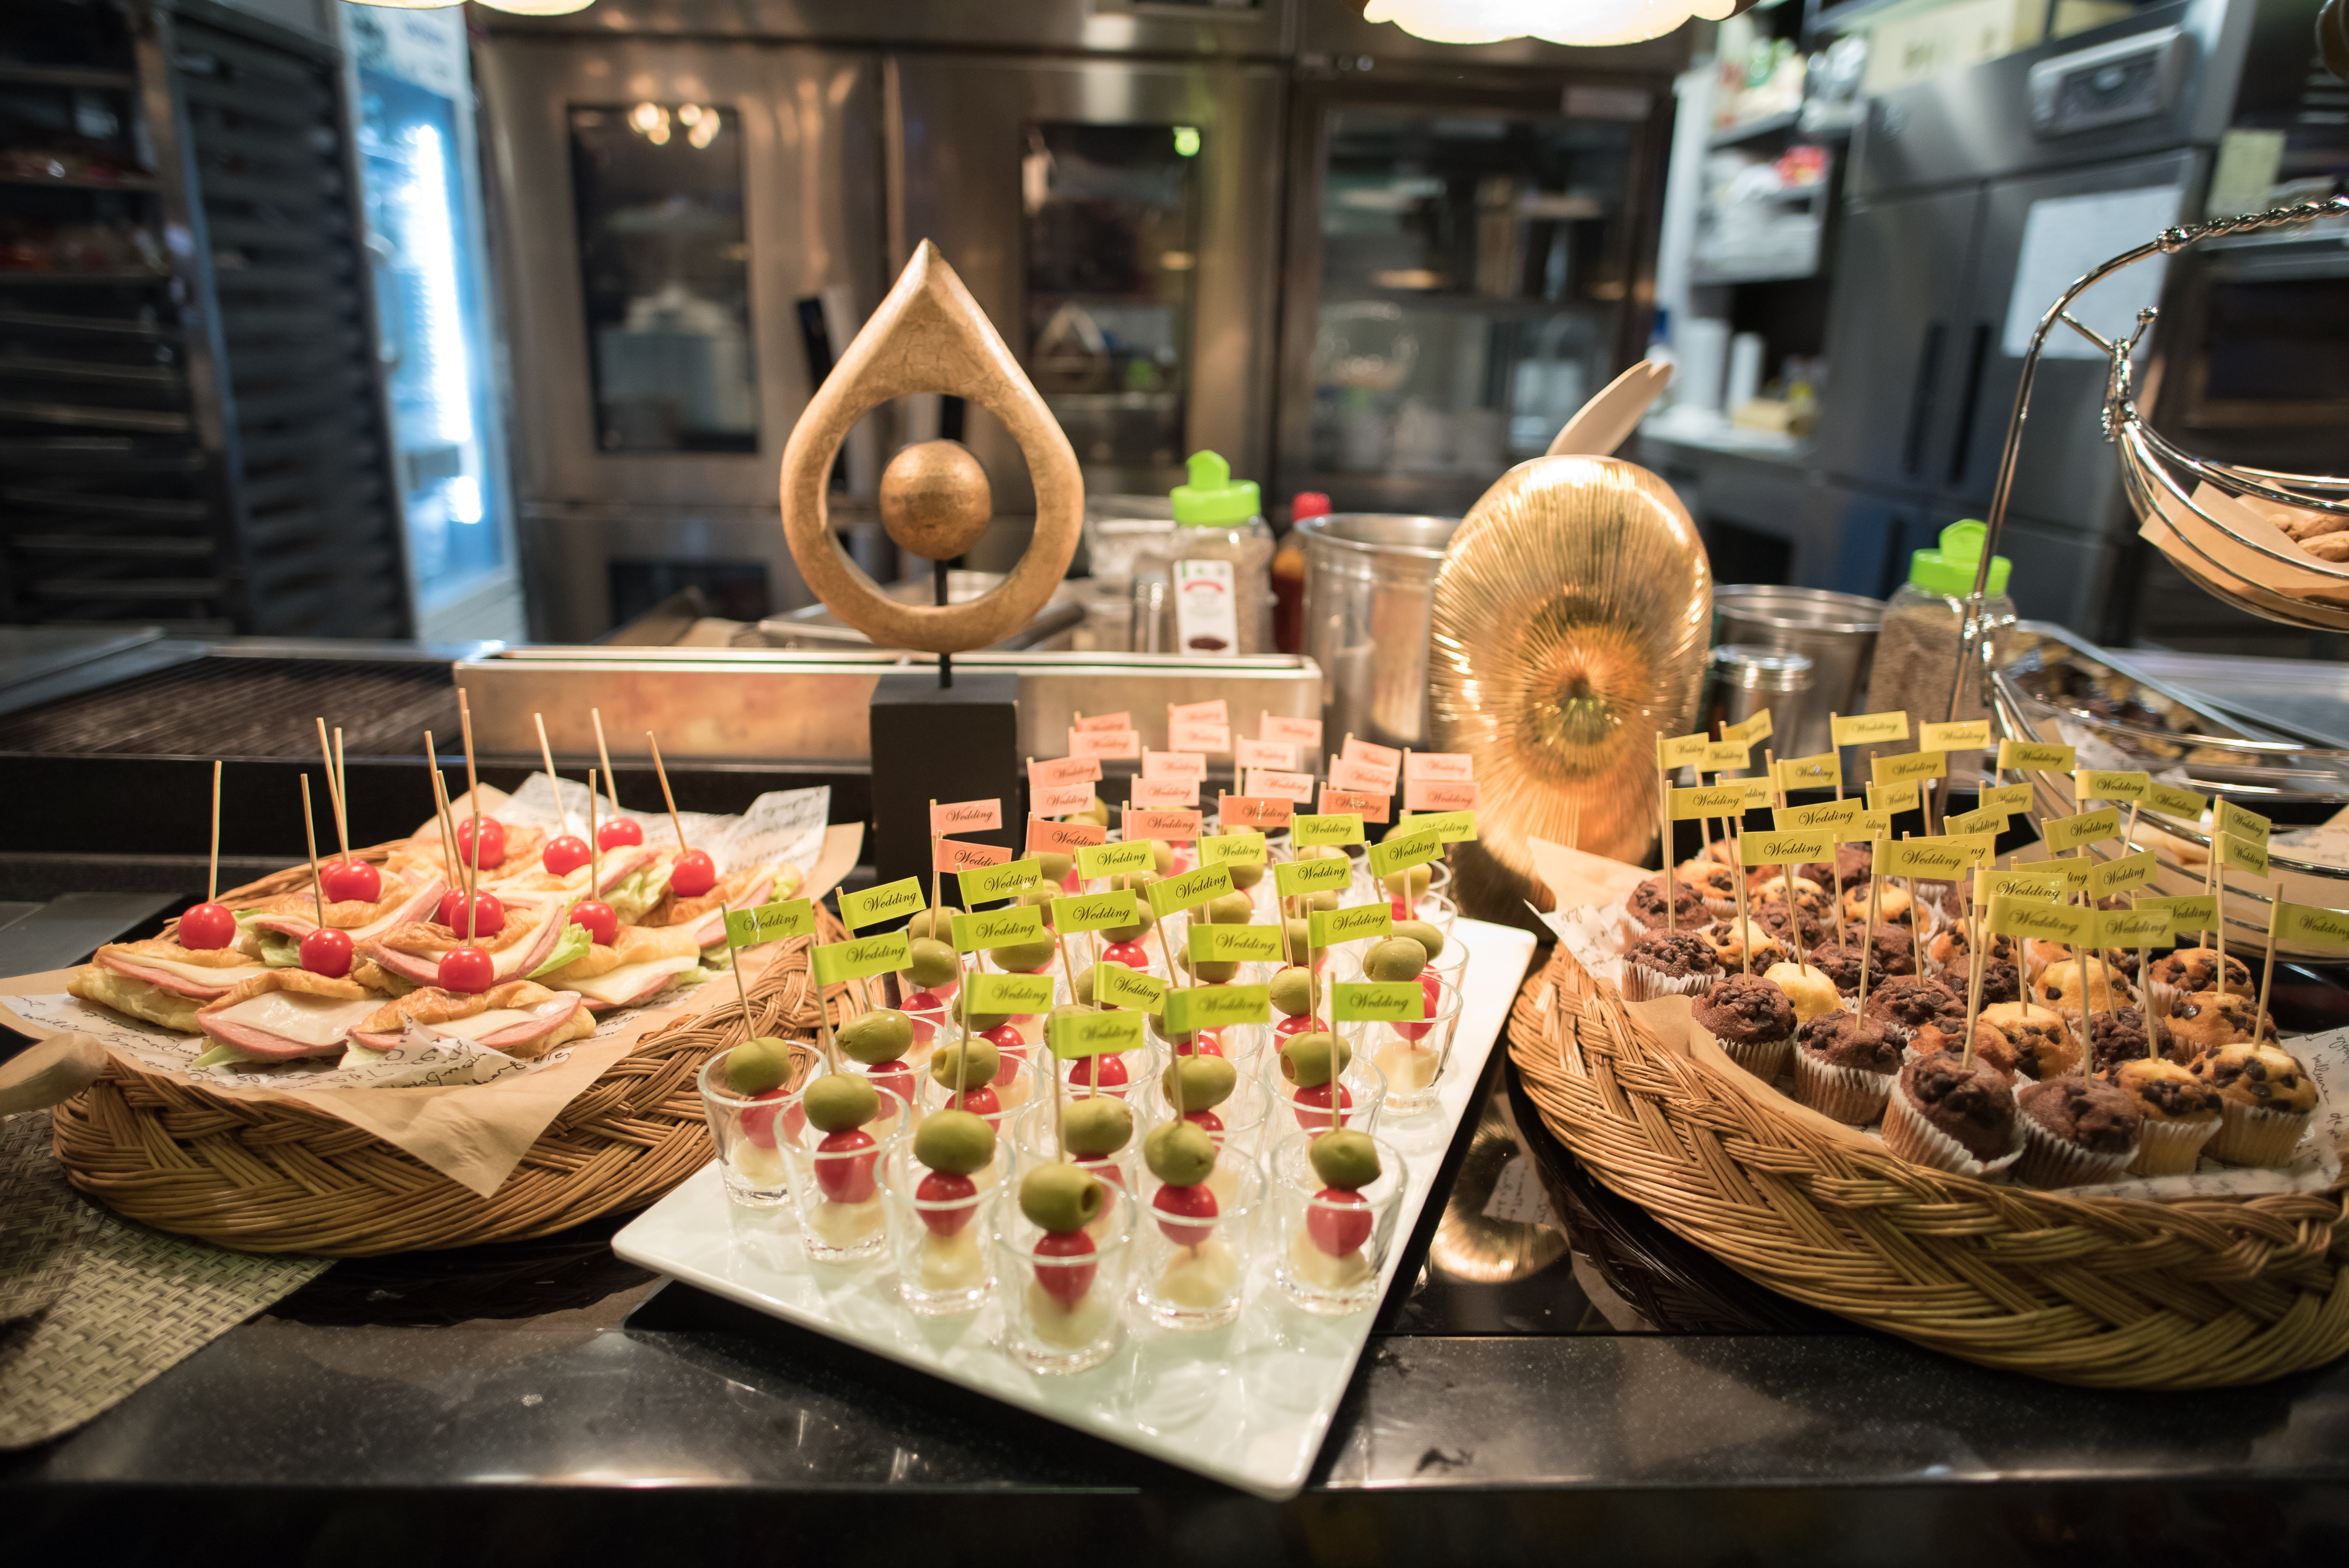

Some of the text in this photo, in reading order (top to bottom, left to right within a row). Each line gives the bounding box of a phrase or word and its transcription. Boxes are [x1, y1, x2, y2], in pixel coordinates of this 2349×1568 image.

[1855, 721, 1897, 732] Wedding
[1090, 738, 1128, 749] Wedding
[1941, 730, 1985, 741] Wedding
[1253, 749, 1287, 762] Wedding
[1676, 743, 1705, 755] Wedding
[1711, 750, 1743, 762] Wedding
[2017, 749, 2063, 765] Wedding
[1053, 765, 1096, 779] Wedding
[1163, 762, 1200, 773] Wedding
[1429, 762, 1466, 774] Wedding
[1796, 763, 1834, 780] Wedding
[1893, 759, 1937, 776] Wedding
[1266, 777, 1308, 792] Wedding
[1352, 770, 1391, 788] Wedding
[2097, 778, 2143, 793] Wedding
[1149, 785, 1191, 798] Wedding
[1428, 791, 1473, 805] Wedding
[1745, 786, 1766, 801] edding
[1886, 790, 1914, 806] Wedding
[1046, 794, 1089, 807] Wedding
[1335, 796, 1381, 815] Wedding
[1694, 792, 1739, 809] Wedding
[2156, 794, 2197, 815] Wedding
[946, 807, 993, 822] Wedding
[1242, 805, 1290, 819] Wedding
[1799, 807, 1855, 826] Wedding
[1148, 817, 1194, 832] Wedding
[1307, 820, 1351, 836] Wedding
[1965, 817, 1999, 834] Wedding
[2071, 817, 2114, 836] Wedding
[2232, 812, 2264, 836] Wedding
[1217, 843, 1260, 858] Wedding
[1390, 840, 1436, 861] Wedding
[1764, 839, 1822, 857] Wedding
[954, 849, 998, 866] Weddin
[1098, 850, 1146, 866] Wedding
[1902, 849, 1961, 870] Wedding
[2234, 845, 2263, 870] Wedding
[1298, 863, 1347, 880] Wedding
[2104, 865, 2145, 886] Wedding
[984, 872, 1038, 893] Wedding
[1176, 873, 1227, 900] Wedding
[1997, 880, 2061, 901] Wedding
[863, 889, 917, 912] Wedding
[743, 912, 799, 932] Wedding
[1073, 904, 1130, 923] Wedding
[1333, 911, 1386, 931] Wedding
[976, 921, 1036, 940] Wedding
[2008, 910, 2078, 936] Wedding
[2105, 916, 2167, 937] Wedding
[1216, 932, 1277, 954] Wedding
[846, 944, 906, 964] Wedding
[992, 985, 1047, 1004] Wedding
[1114, 975, 1160, 1001] Wedding
[1199, 993, 1264, 1015] Wedding
[1350, 991, 1409, 1011] Wedding
[1082, 1024, 1137, 1043] Wedding
